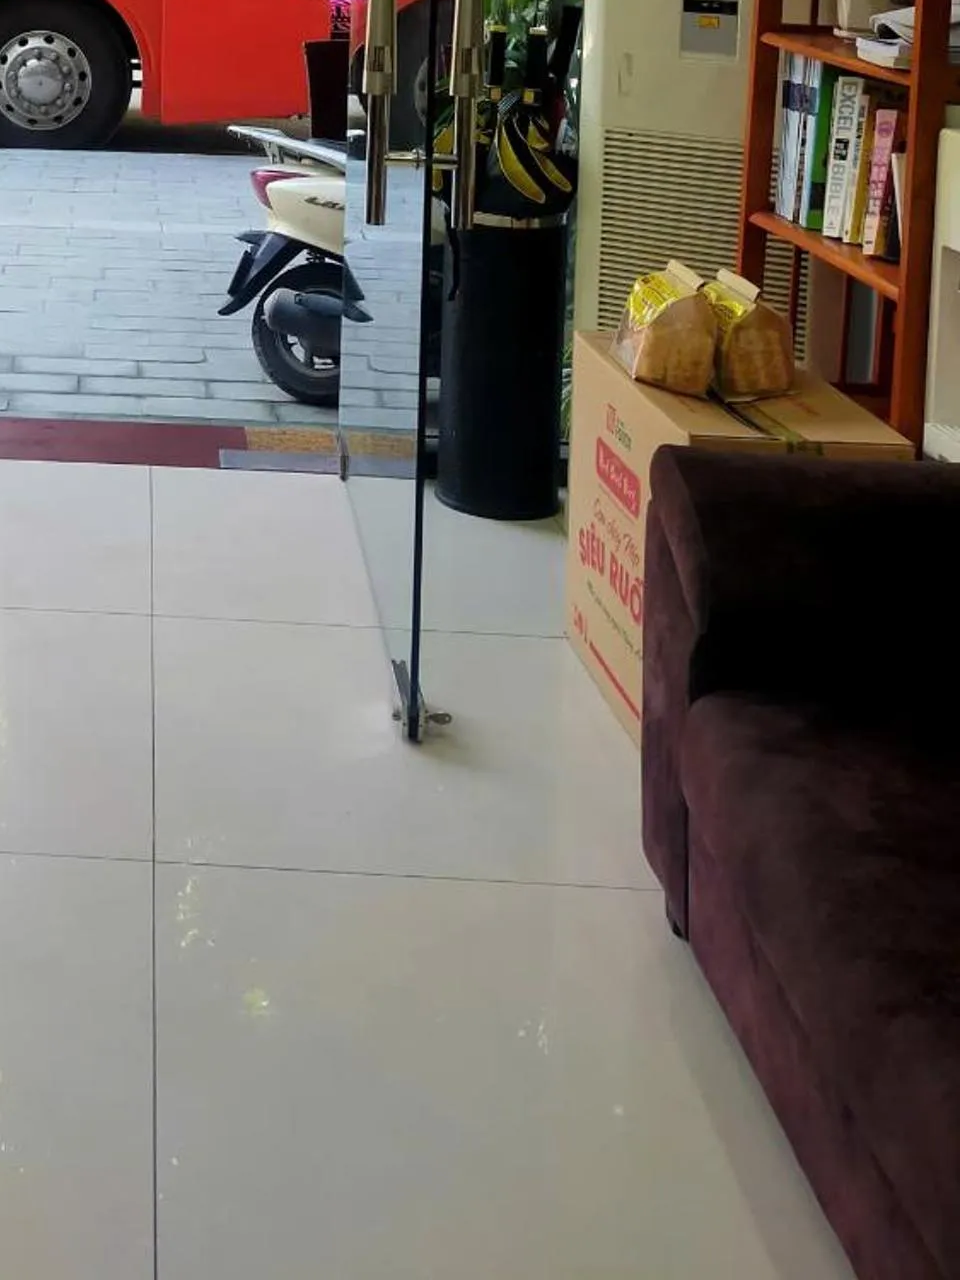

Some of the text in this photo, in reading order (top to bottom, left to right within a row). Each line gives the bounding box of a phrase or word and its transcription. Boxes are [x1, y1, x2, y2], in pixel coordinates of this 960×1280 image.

[836, 81, 857, 135] EXCEL
[827, 163, 846, 217] BIBLE
[609, 553, 643, 625] RUỐ
